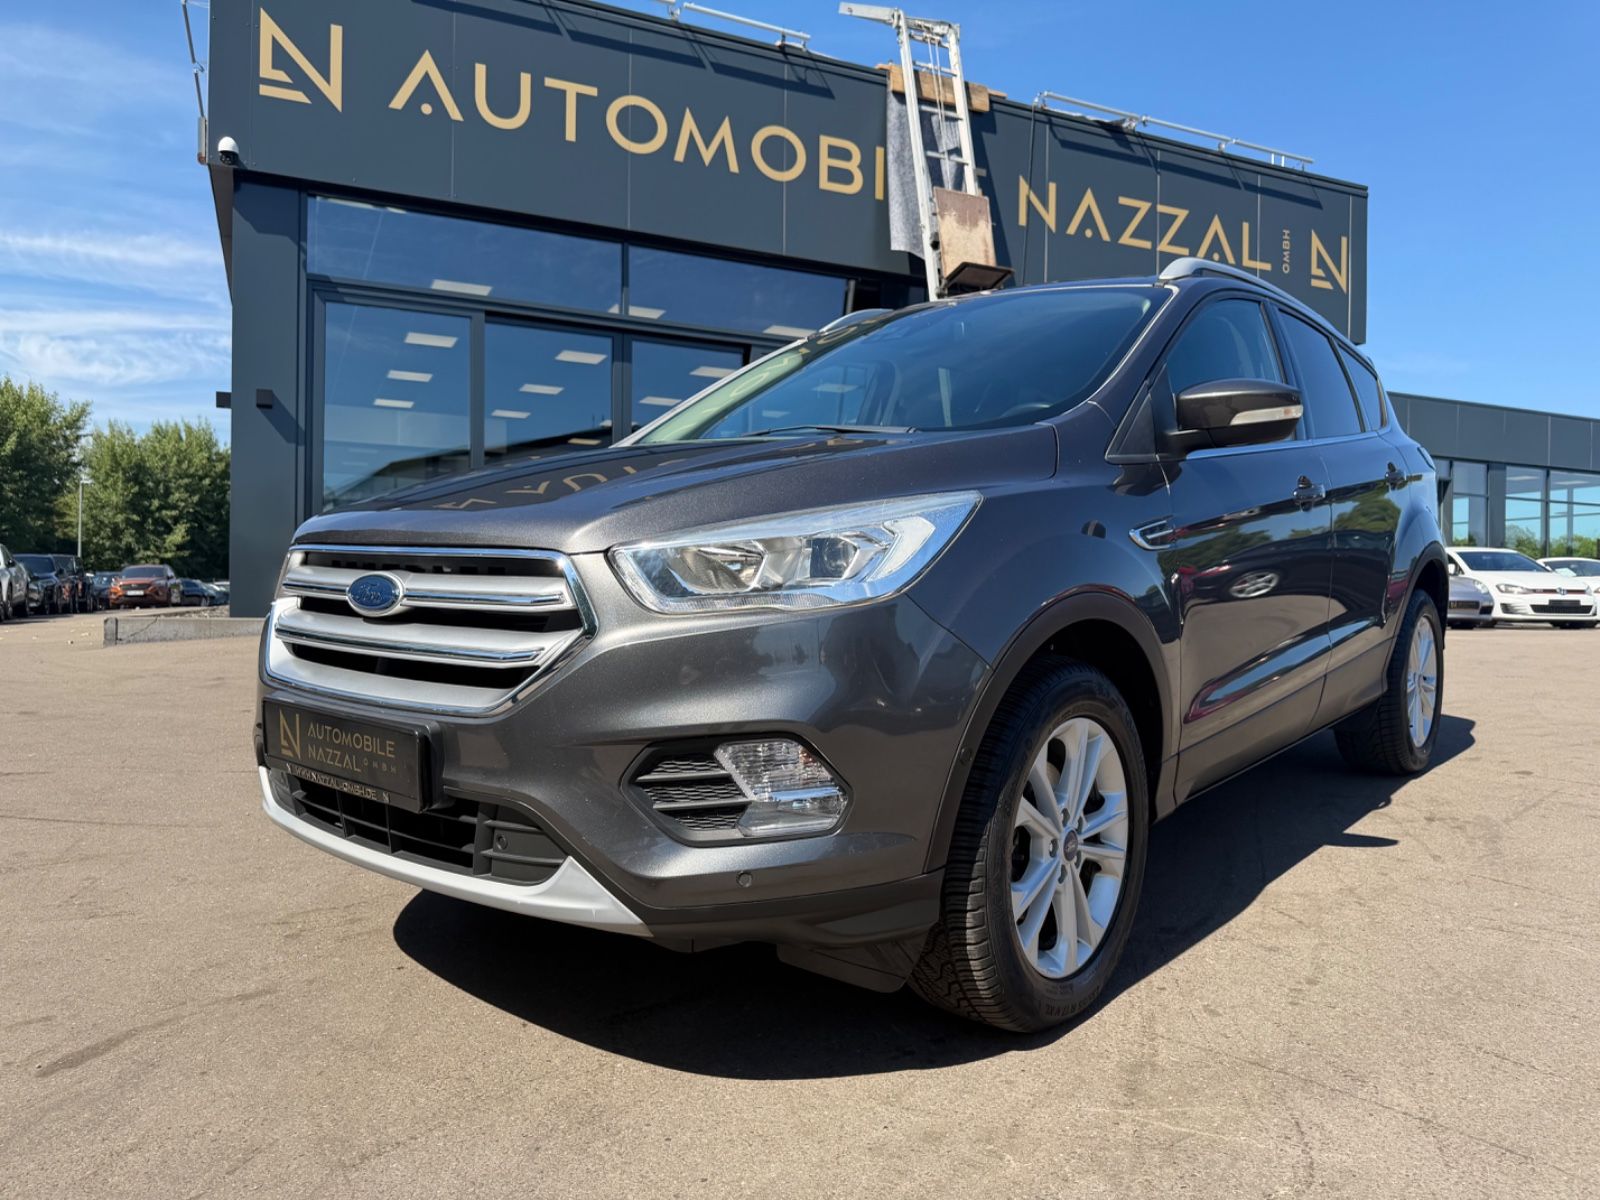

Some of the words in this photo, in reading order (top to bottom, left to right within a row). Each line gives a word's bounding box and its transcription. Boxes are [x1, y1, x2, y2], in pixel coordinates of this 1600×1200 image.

[388, 49, 986, 200] AUTOMOBI
[1018, 175, 1272, 271] NAZZAL
[307, 722, 396, 758] AUTOMOBILE
[307, 744, 362, 772] NAZZAL
